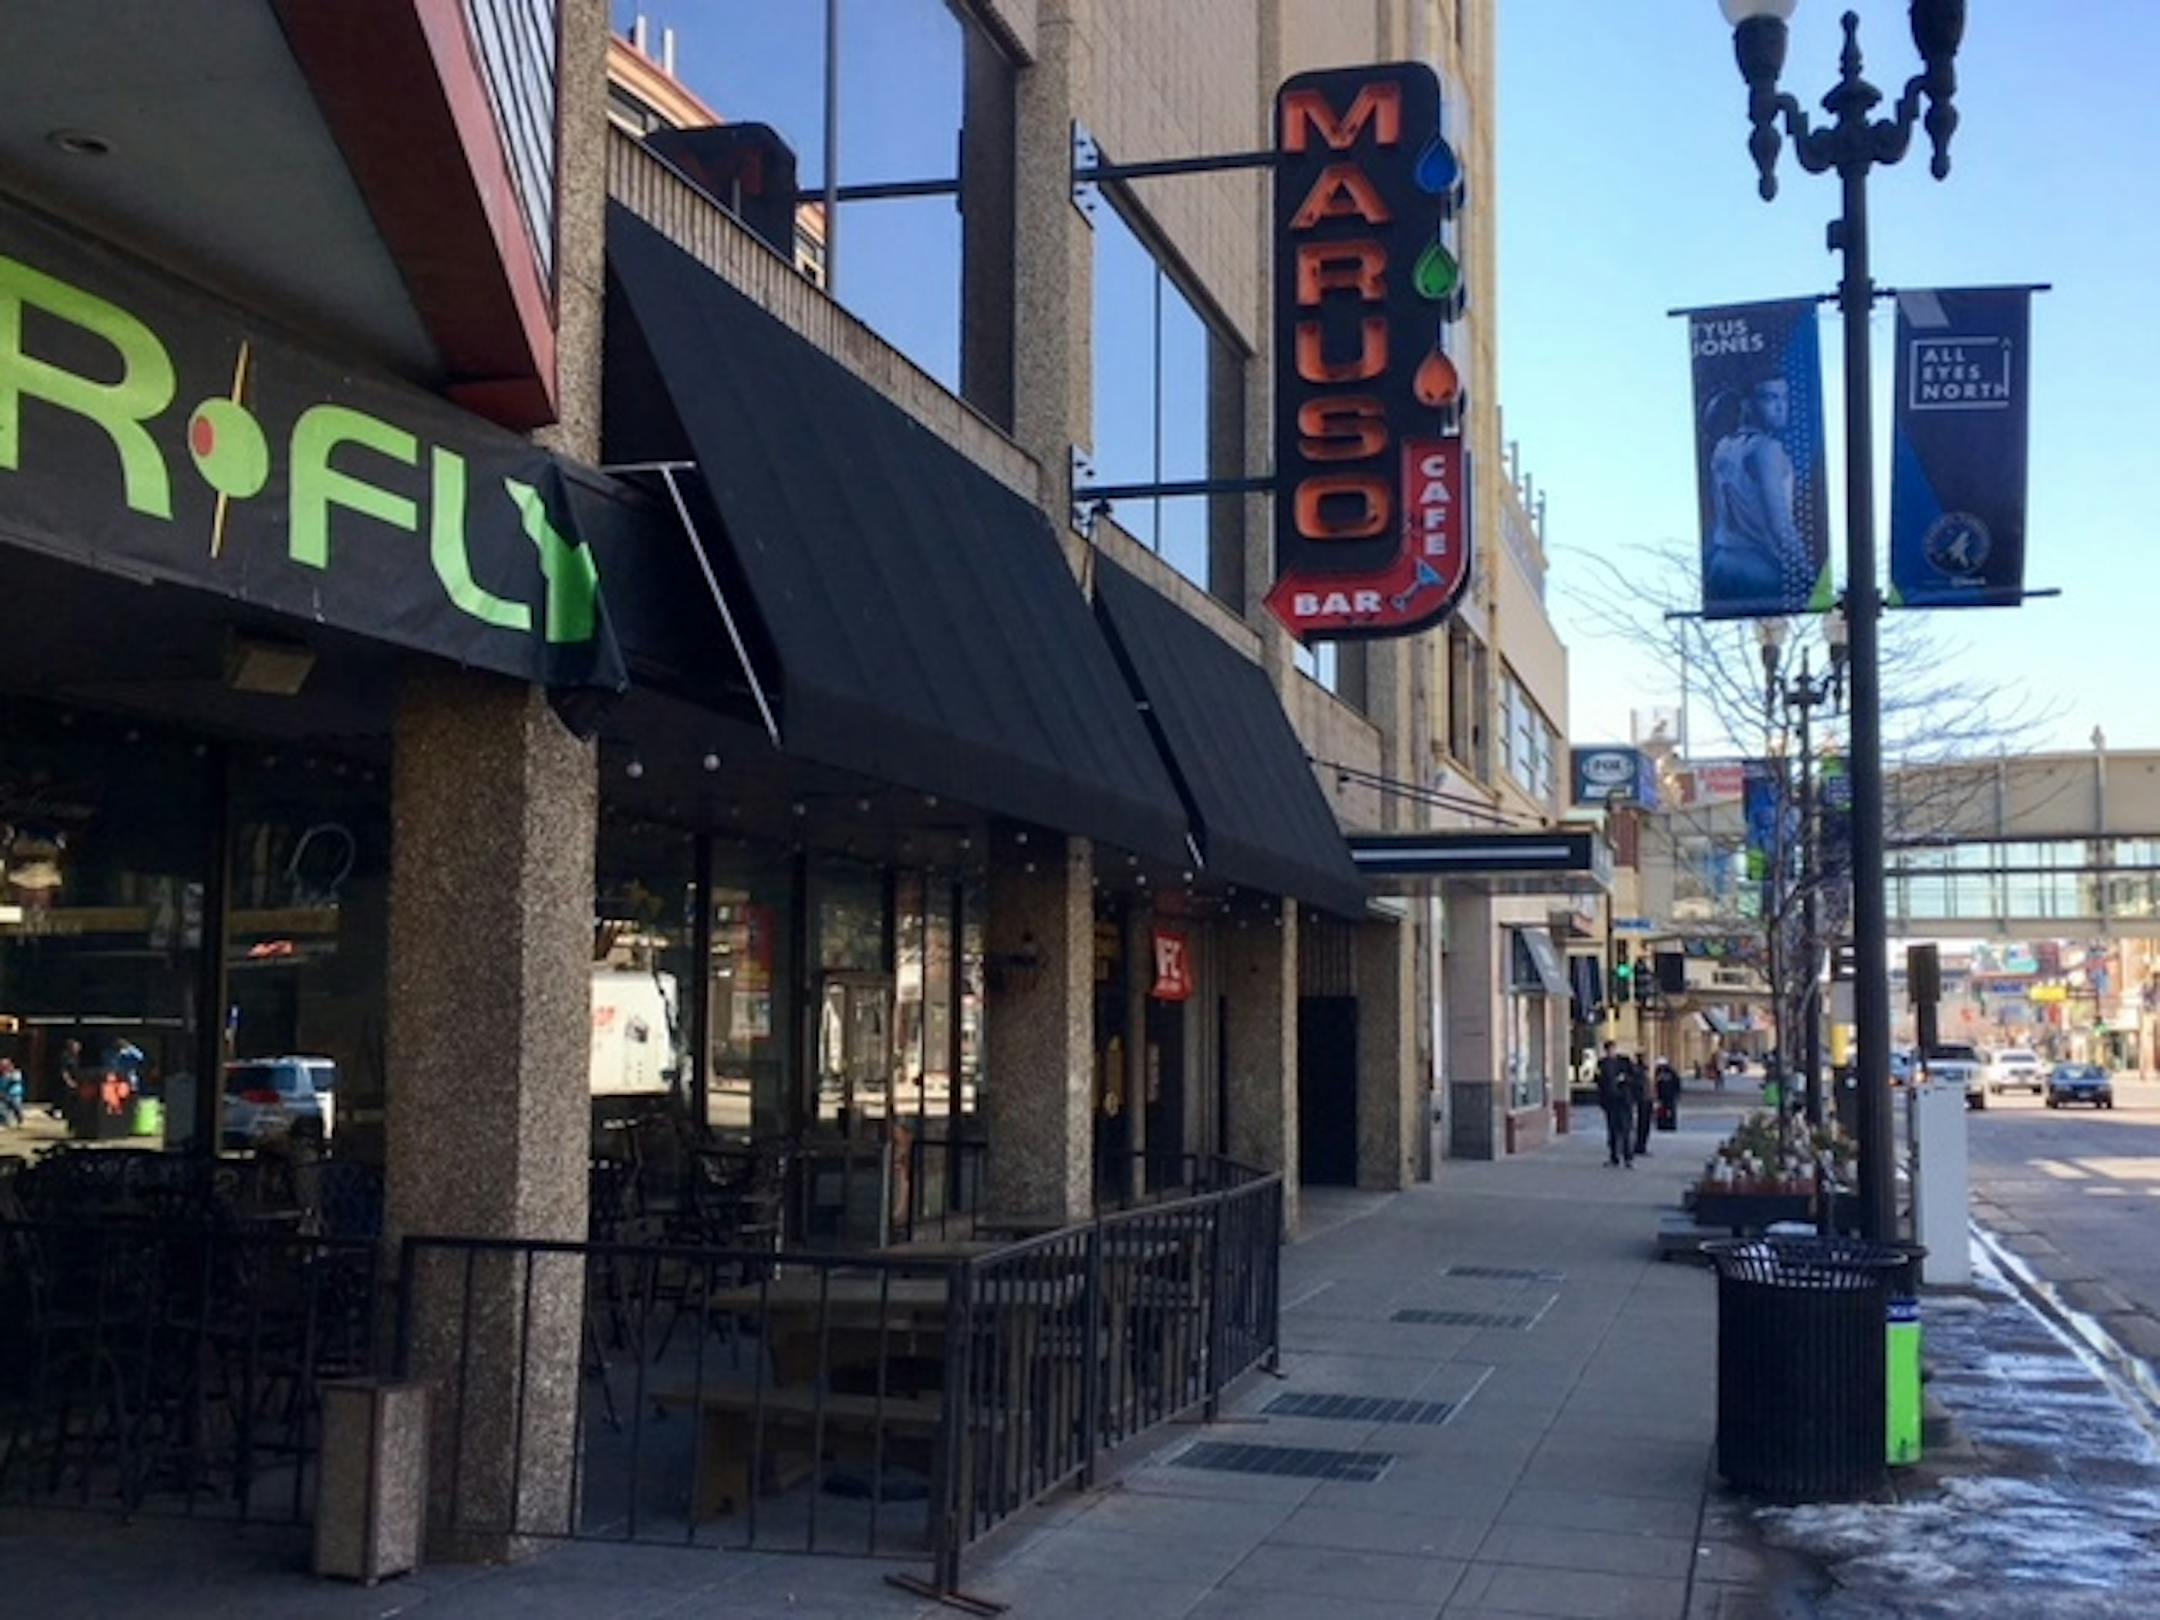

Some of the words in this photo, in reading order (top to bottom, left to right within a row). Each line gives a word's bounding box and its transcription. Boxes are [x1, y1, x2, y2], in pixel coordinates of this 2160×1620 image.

[1284, 84, 1400, 538] MARUSO
[1923, 347, 1966, 362] ALL
[1923, 383, 2010, 399] NORTH
[1420, 455, 1450, 554] CAFE
[1294, 591, 1382, 616] BAR
